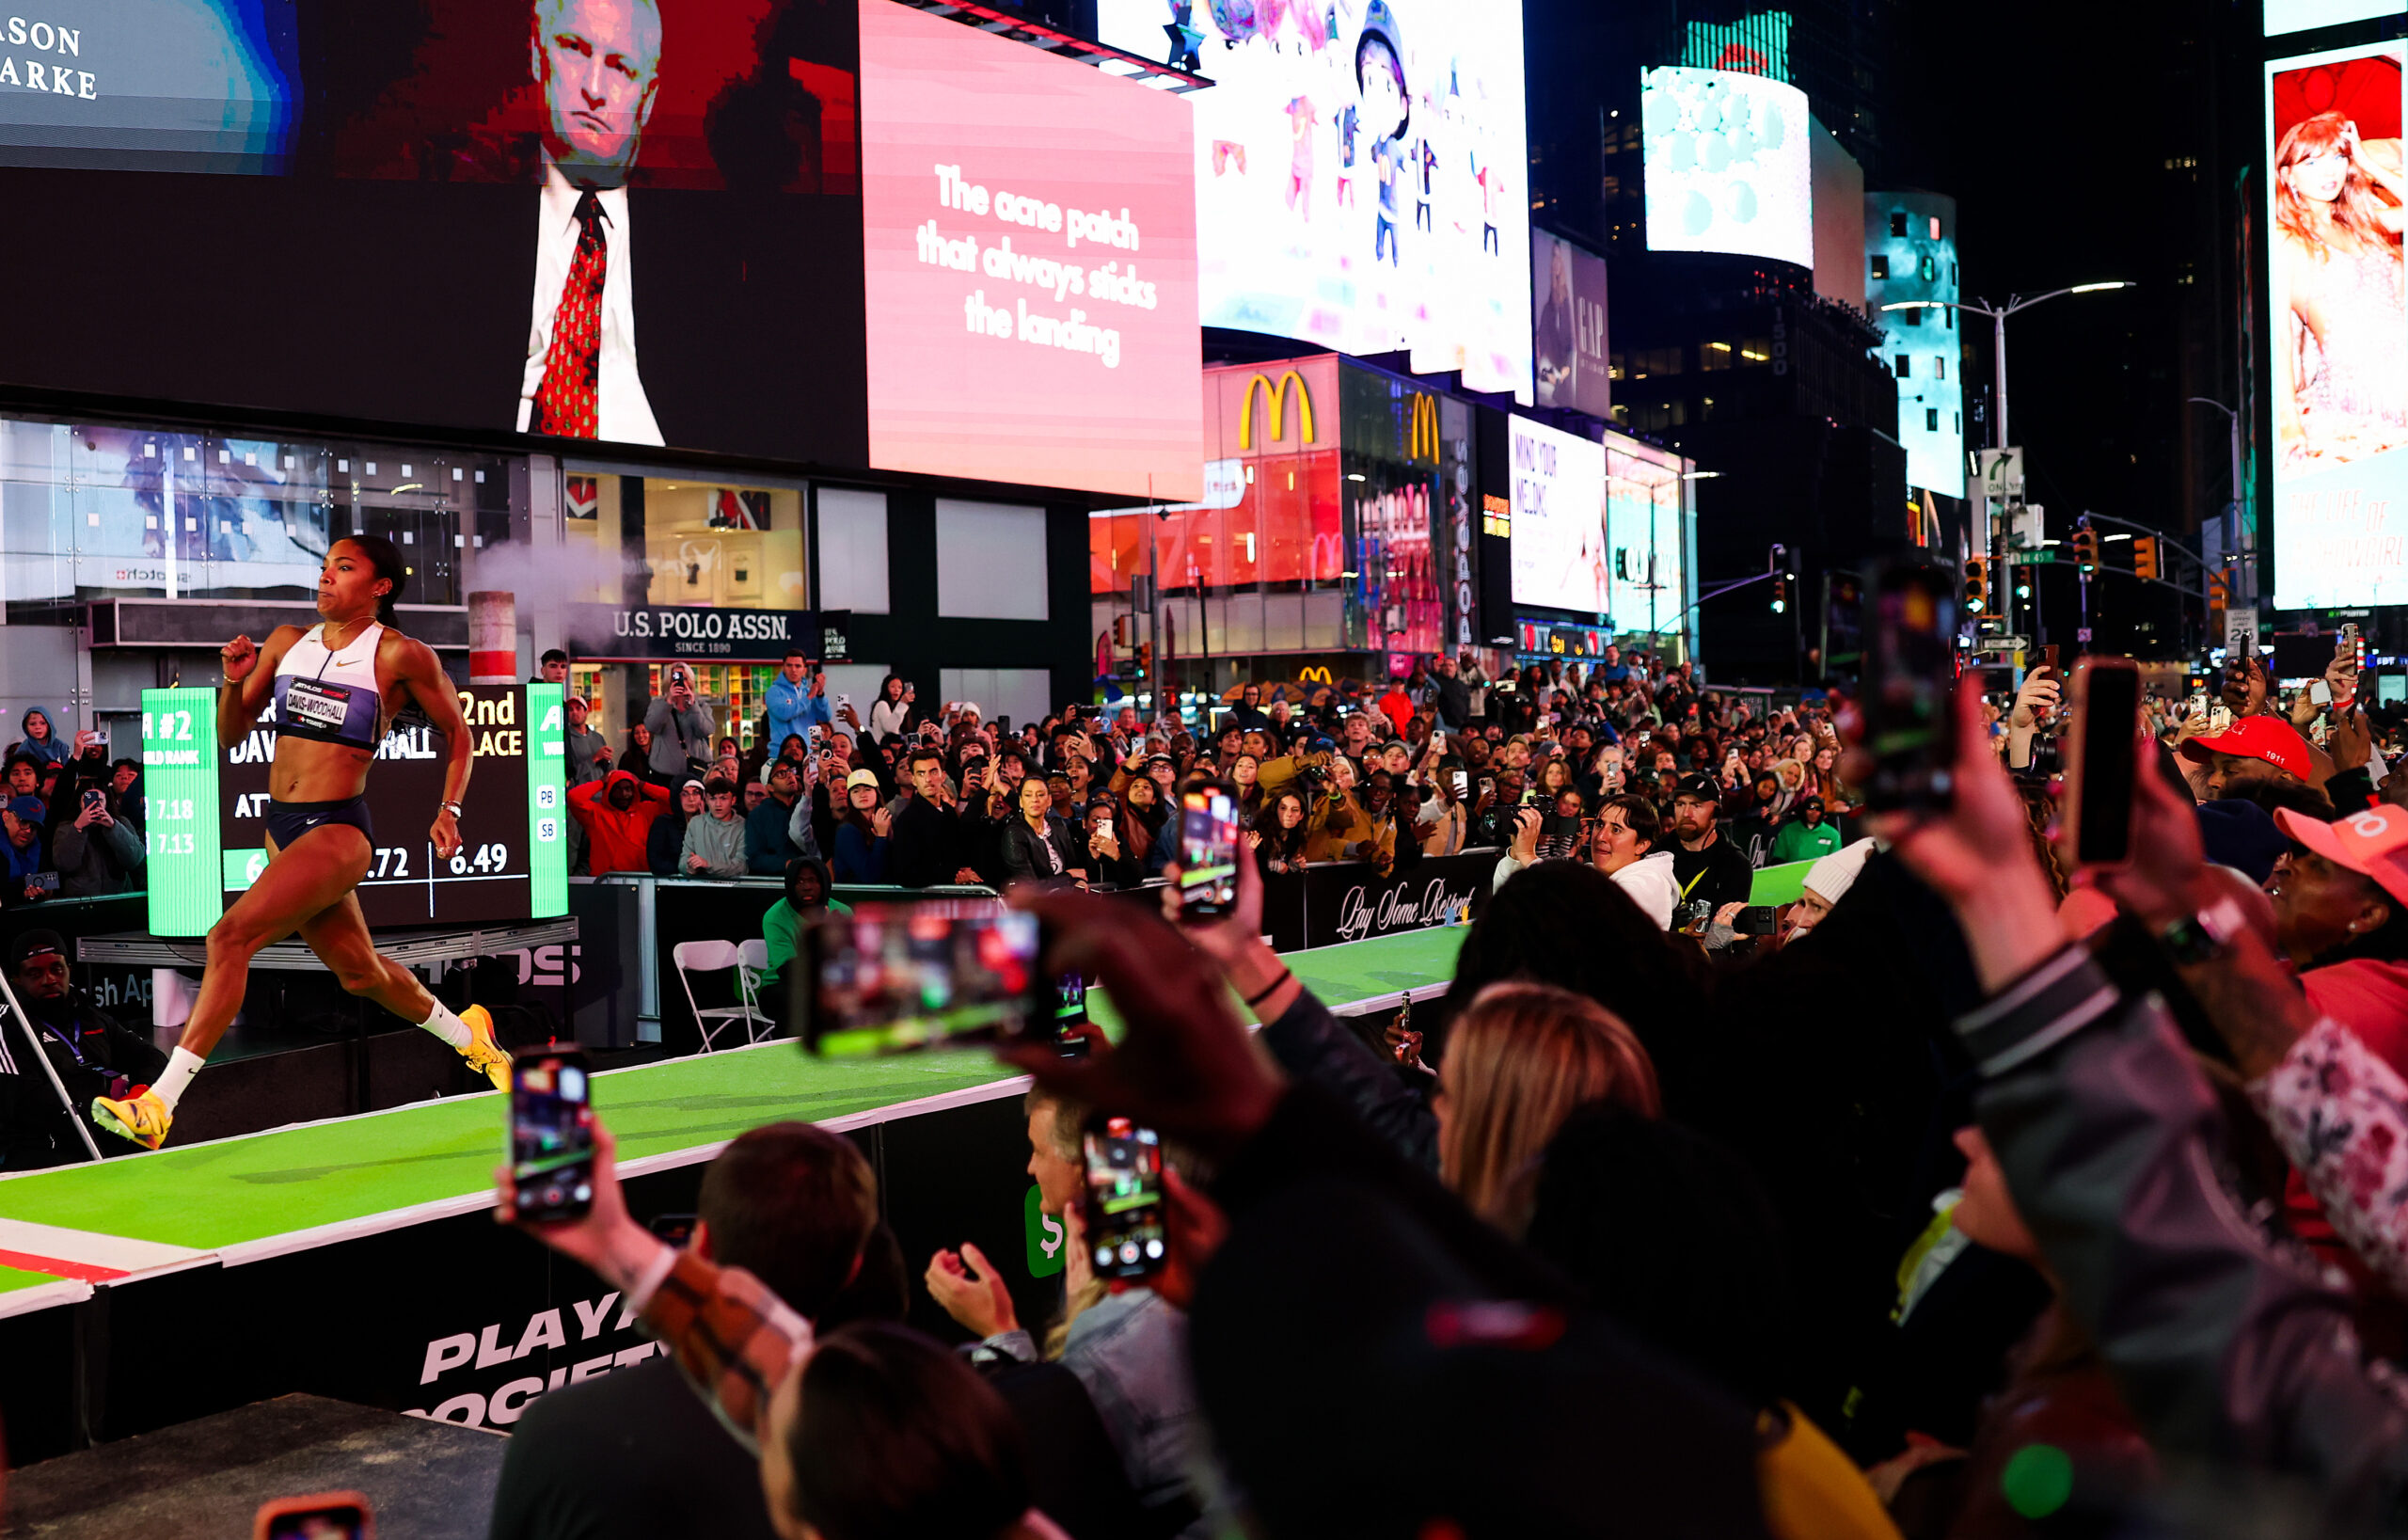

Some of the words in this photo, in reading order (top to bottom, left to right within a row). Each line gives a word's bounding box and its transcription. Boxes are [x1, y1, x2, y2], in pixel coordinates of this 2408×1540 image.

[0, 56, 97, 101] ARKE
[935, 164, 990, 215] The
[994, 191, 1062, 232] acne
[1067, 208, 1139, 251] patch
[916, 219, 978, 272] that
[983, 236, 1085, 302] always
[1088, 261, 1157, 310] sticks
[964, 290, 1013, 339] the
[1018, 297, 1120, 369] landing
[614, 611, 654, 637] U.S.
[658, 612, 723, 640] POLO
[726, 614, 792, 641] ASSN.
[674, 642, 705, 654] SINCE
[708, 643, 731, 654] 1890
[294, 682, 323, 693] ATHLOS
[288, 693, 342, 721] DAVIS-WOODHALL
[458, 691, 515, 725] 2nd
[159, 710, 193, 740] #2
[473, 730, 522, 756] ACE
[2266, 750, 2286, 765] 1911
[157, 800, 194, 820] 7.18
[235, 793, 271, 818] AT
[541, 791, 553, 804] PB
[158, 834, 195, 854] 7.13
[542, 823, 553, 837] SB
[450, 843, 508, 875] 6.49
[1336, 885, 1375, 941] Pay
[1377, 881, 1419, 930] Some
